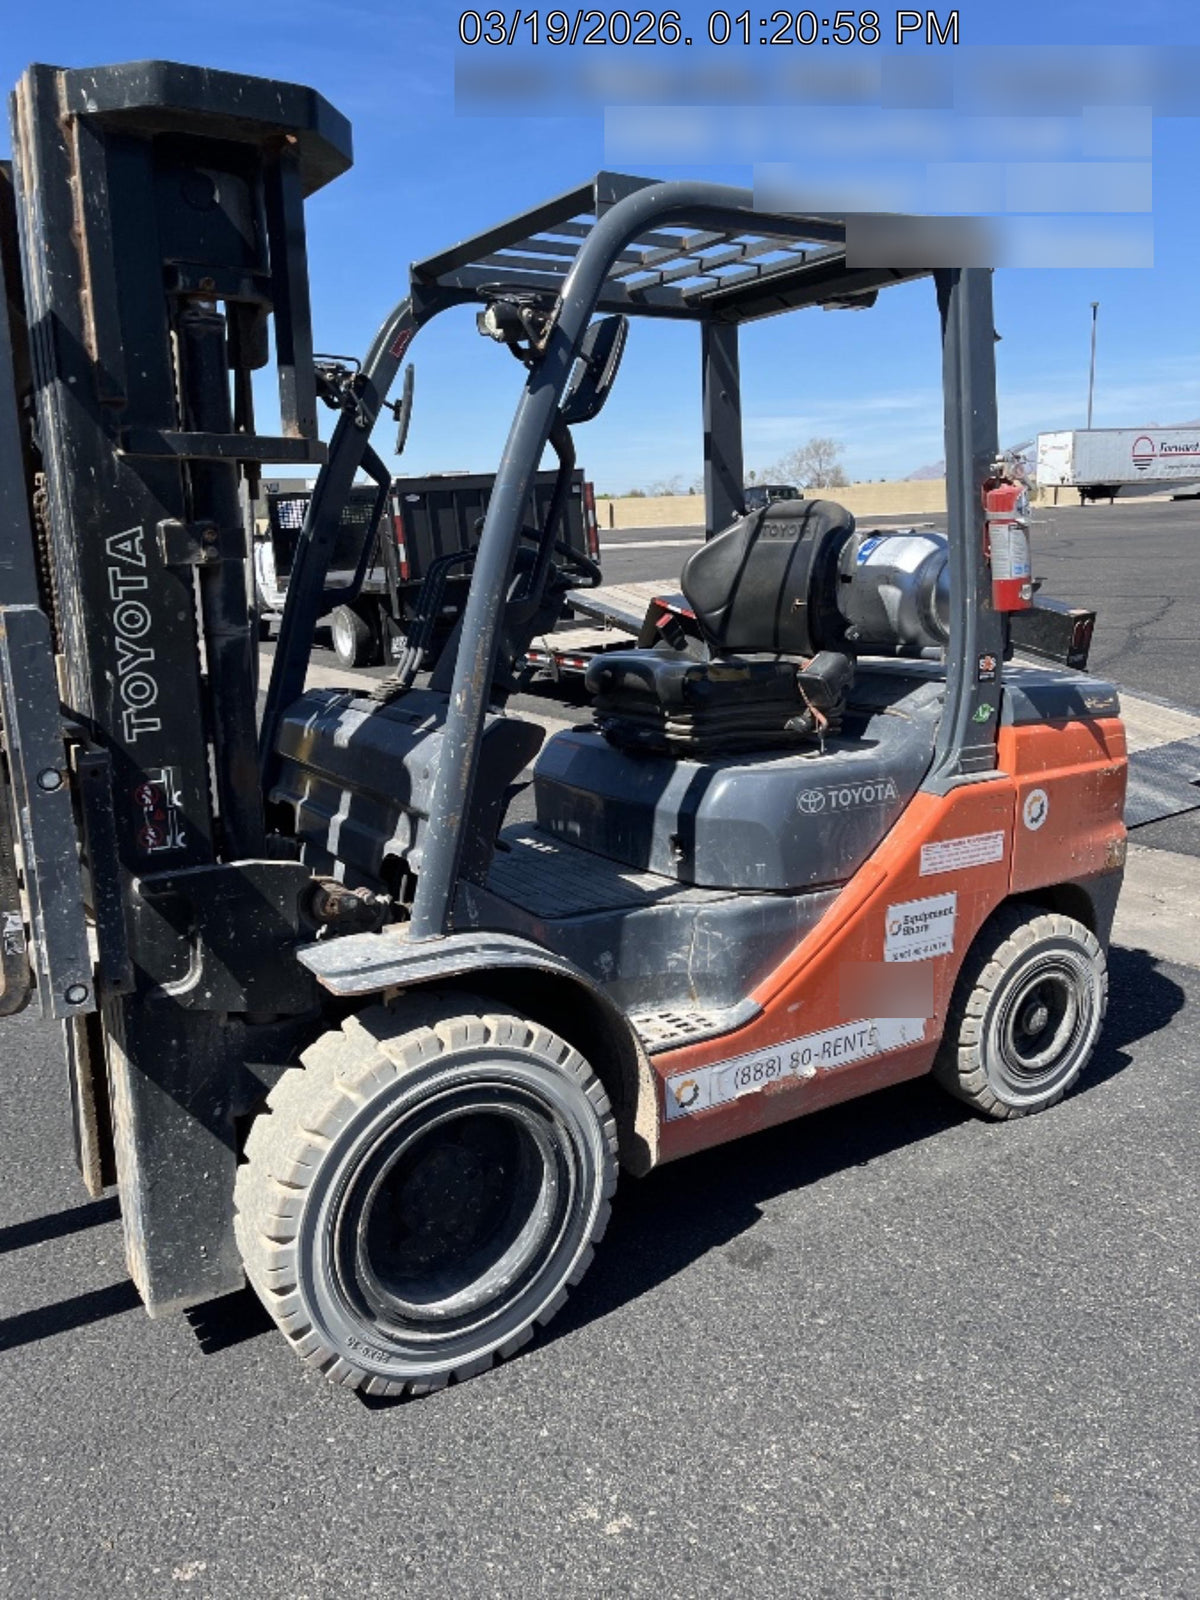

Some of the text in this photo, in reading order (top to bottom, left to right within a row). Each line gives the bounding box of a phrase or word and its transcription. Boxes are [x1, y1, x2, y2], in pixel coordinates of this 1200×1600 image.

[106, 525, 161, 743] TOYOTA
[828, 783, 896, 808] TOYOTA
[734, 1055, 782, 1090] (888)
